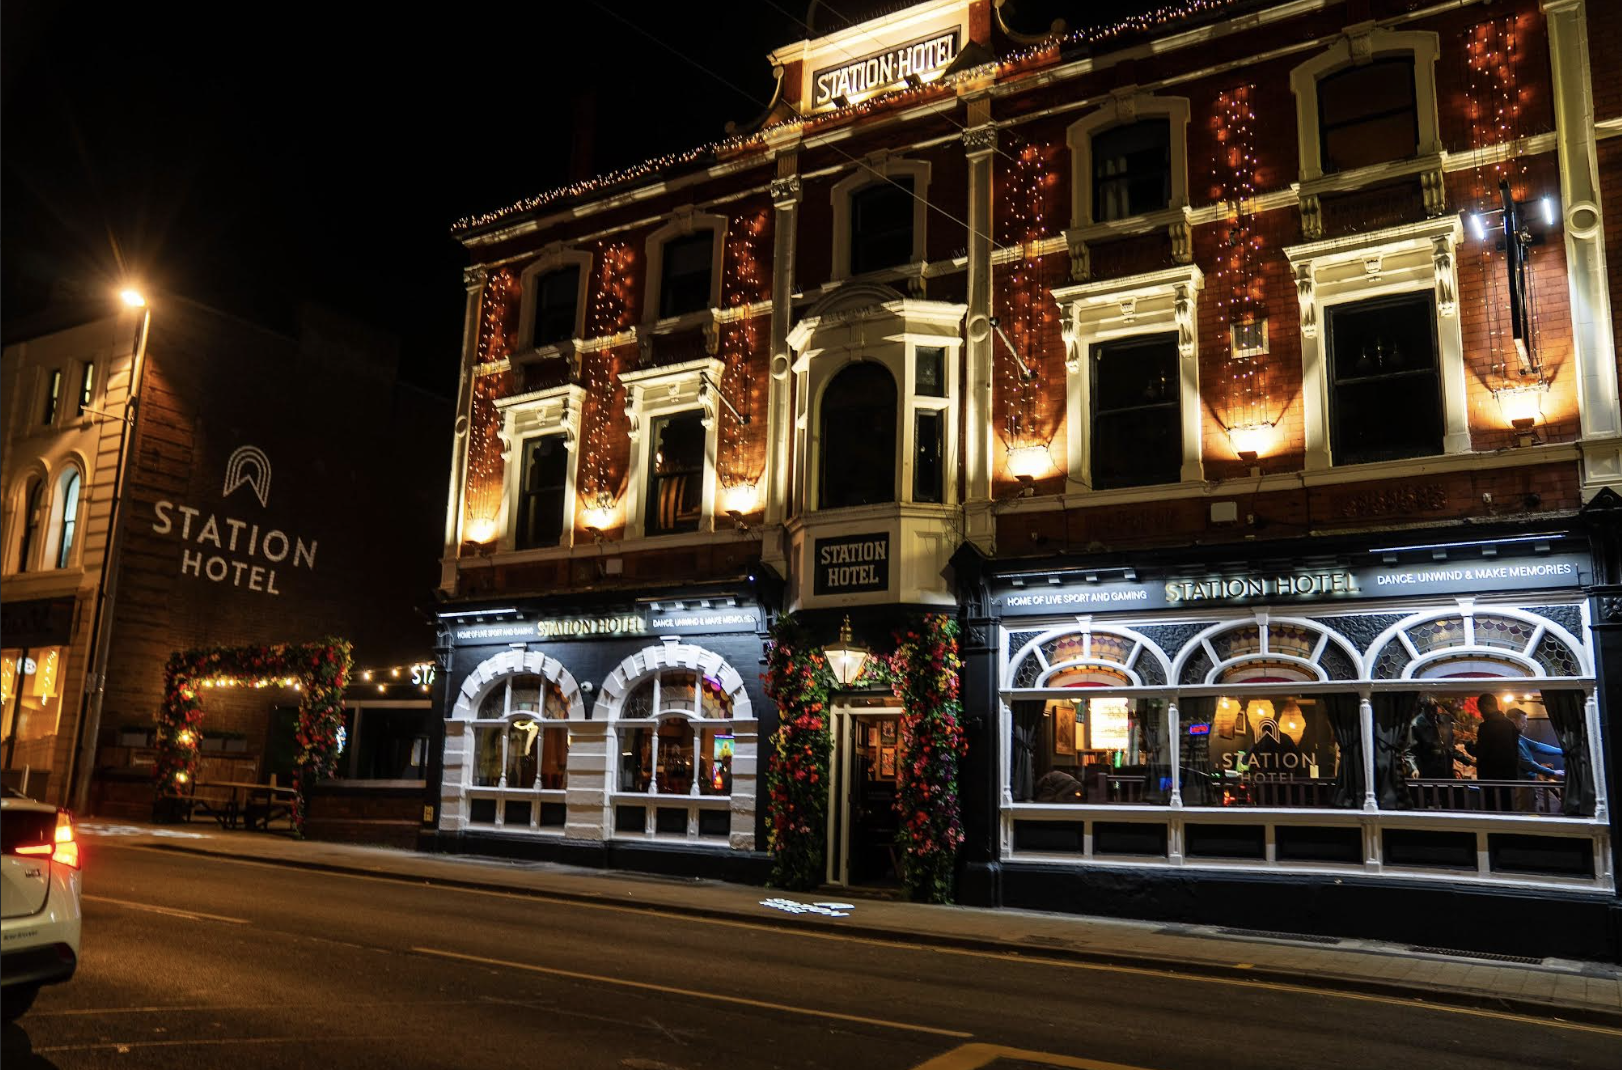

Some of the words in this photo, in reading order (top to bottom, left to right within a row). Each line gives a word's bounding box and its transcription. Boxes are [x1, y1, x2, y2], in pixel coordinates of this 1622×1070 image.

[152, 500, 319, 571] STATION
[821, 541, 887, 565] STATION
[182, 548, 280, 596] HOTEL
[828, 565, 879, 587] HOTEL
[1417, 570, 1463, 583] UNWIND
[1465, 570, 1474, 581] &
[1475, 567, 1507, 580] MAKE
[1508, 563, 1572, 577] MEMORIES
[1165, 578, 1266, 604] STATION
[1275, 571, 1362, 597] HOTEL
[1007, 596, 1031, 607] HOME
[1032, 595, 1044, 605] OF
[1045, 594, 1062, 604] LIVE
[1063, 593, 1090, 604] SPORT
[1091, 592, 1110, 602] AND
[1111, 590, 1148, 602] GAMING
[537, 619, 596, 637] STATION
[598, 616, 645, 634] HOTEL
[705, 616, 722, 625] MAKE
[457, 631, 472, 639] HOME
[488, 628, 503, 637] SPORT
[503, 628, 513, 636] AND
[1222, 751, 1317, 770] STATION
